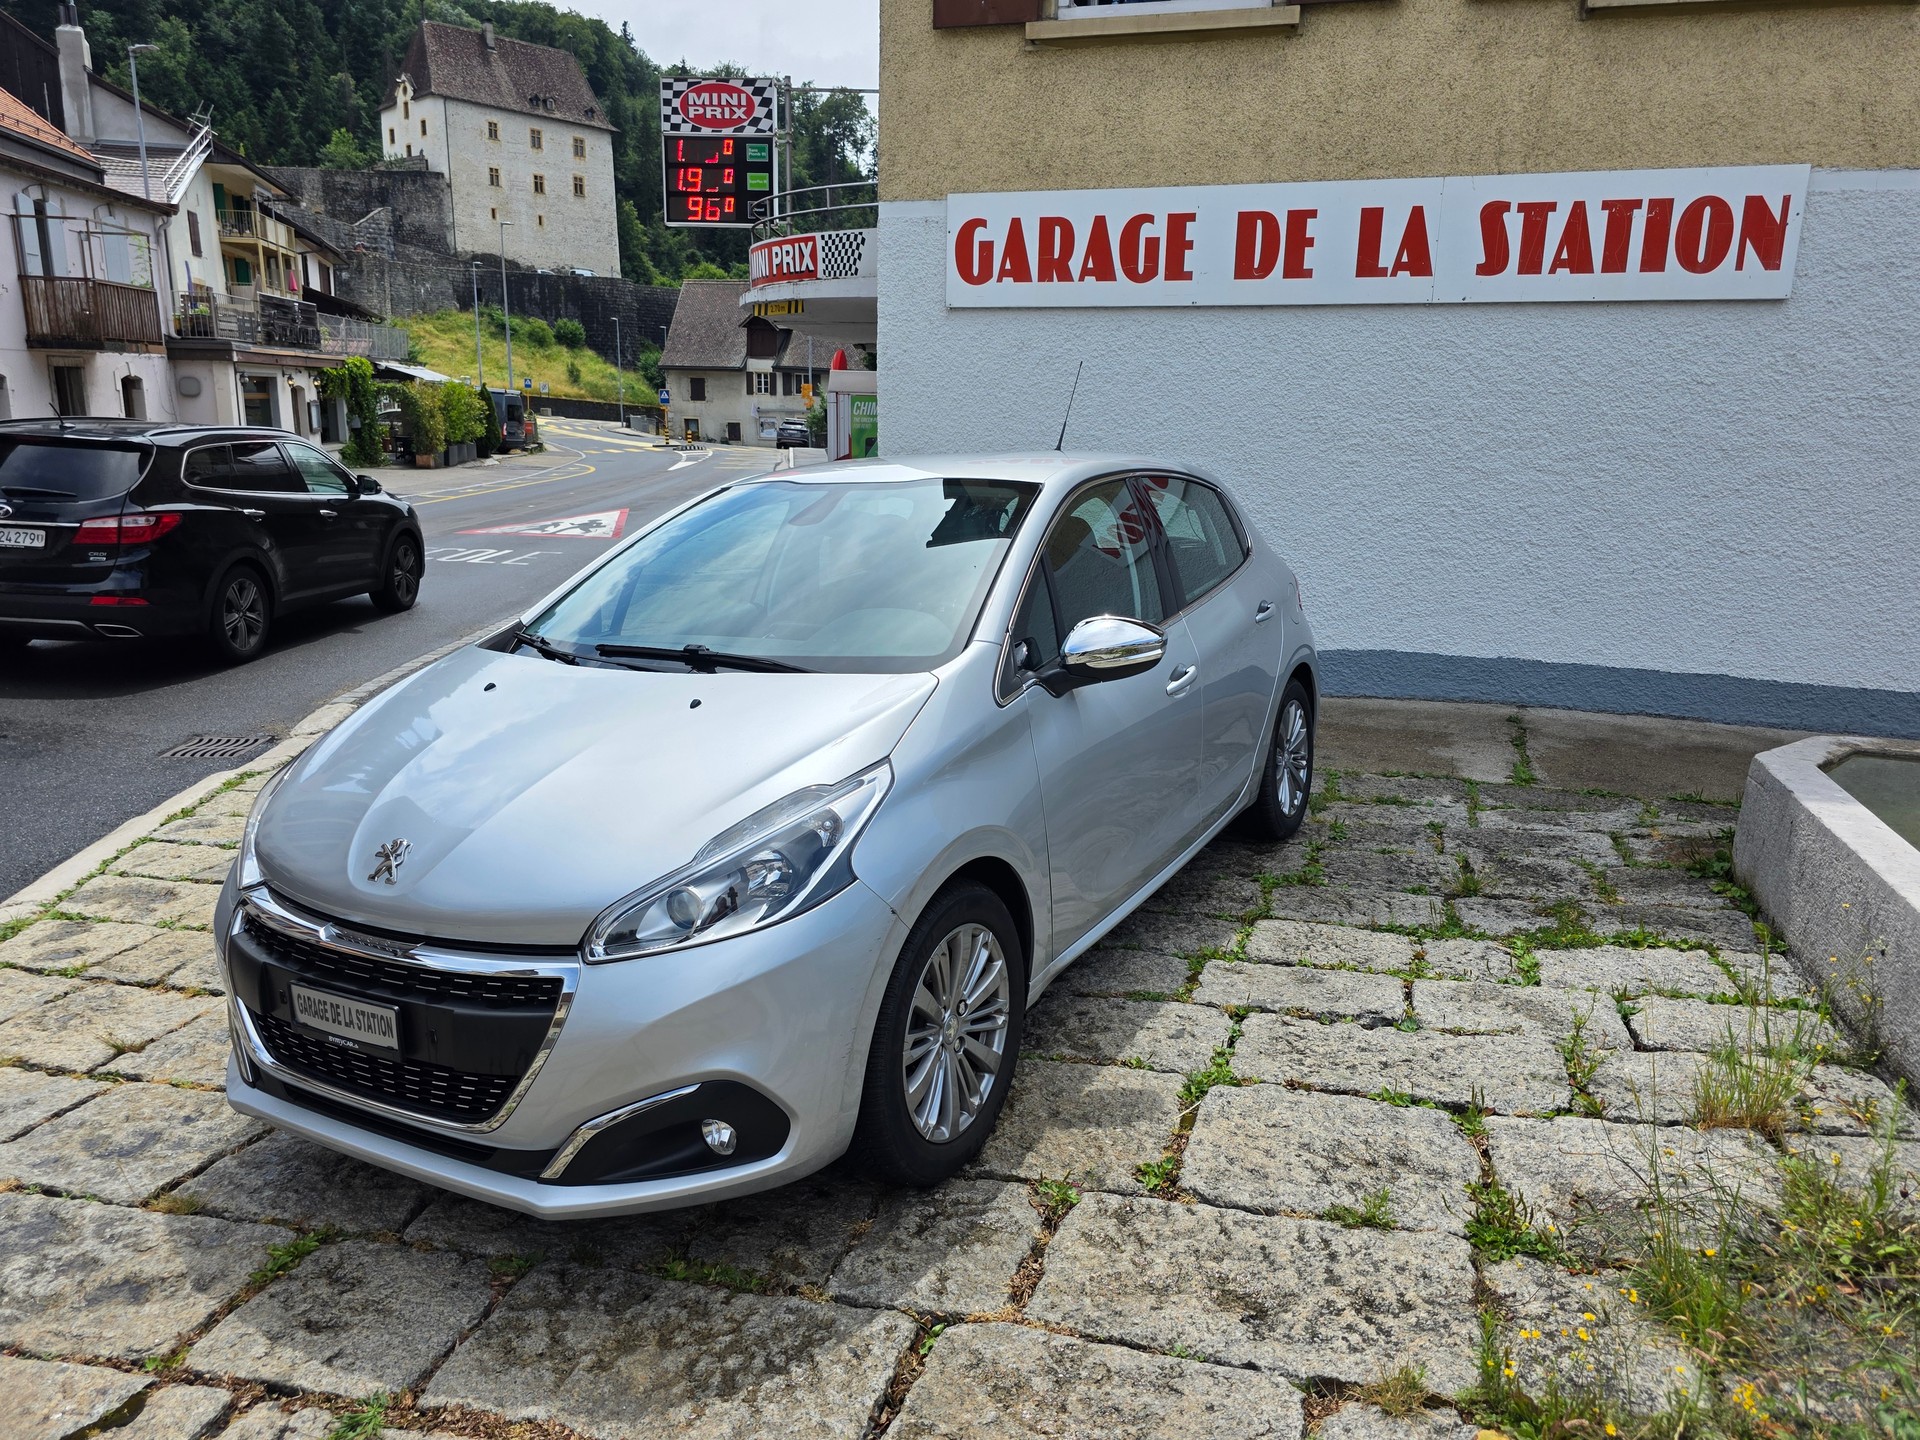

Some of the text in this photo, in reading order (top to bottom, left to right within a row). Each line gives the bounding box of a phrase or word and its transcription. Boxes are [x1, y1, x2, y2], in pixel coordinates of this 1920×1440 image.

[688, 92, 747, 106] MINI
[688, 106, 748, 119] PRIX
[954, 194, 1792, 286] GARAGE DE LA STATION
[771, 241, 815, 275] PRIX
[296, 993, 394, 1039] GARAGE DE LA STATION
